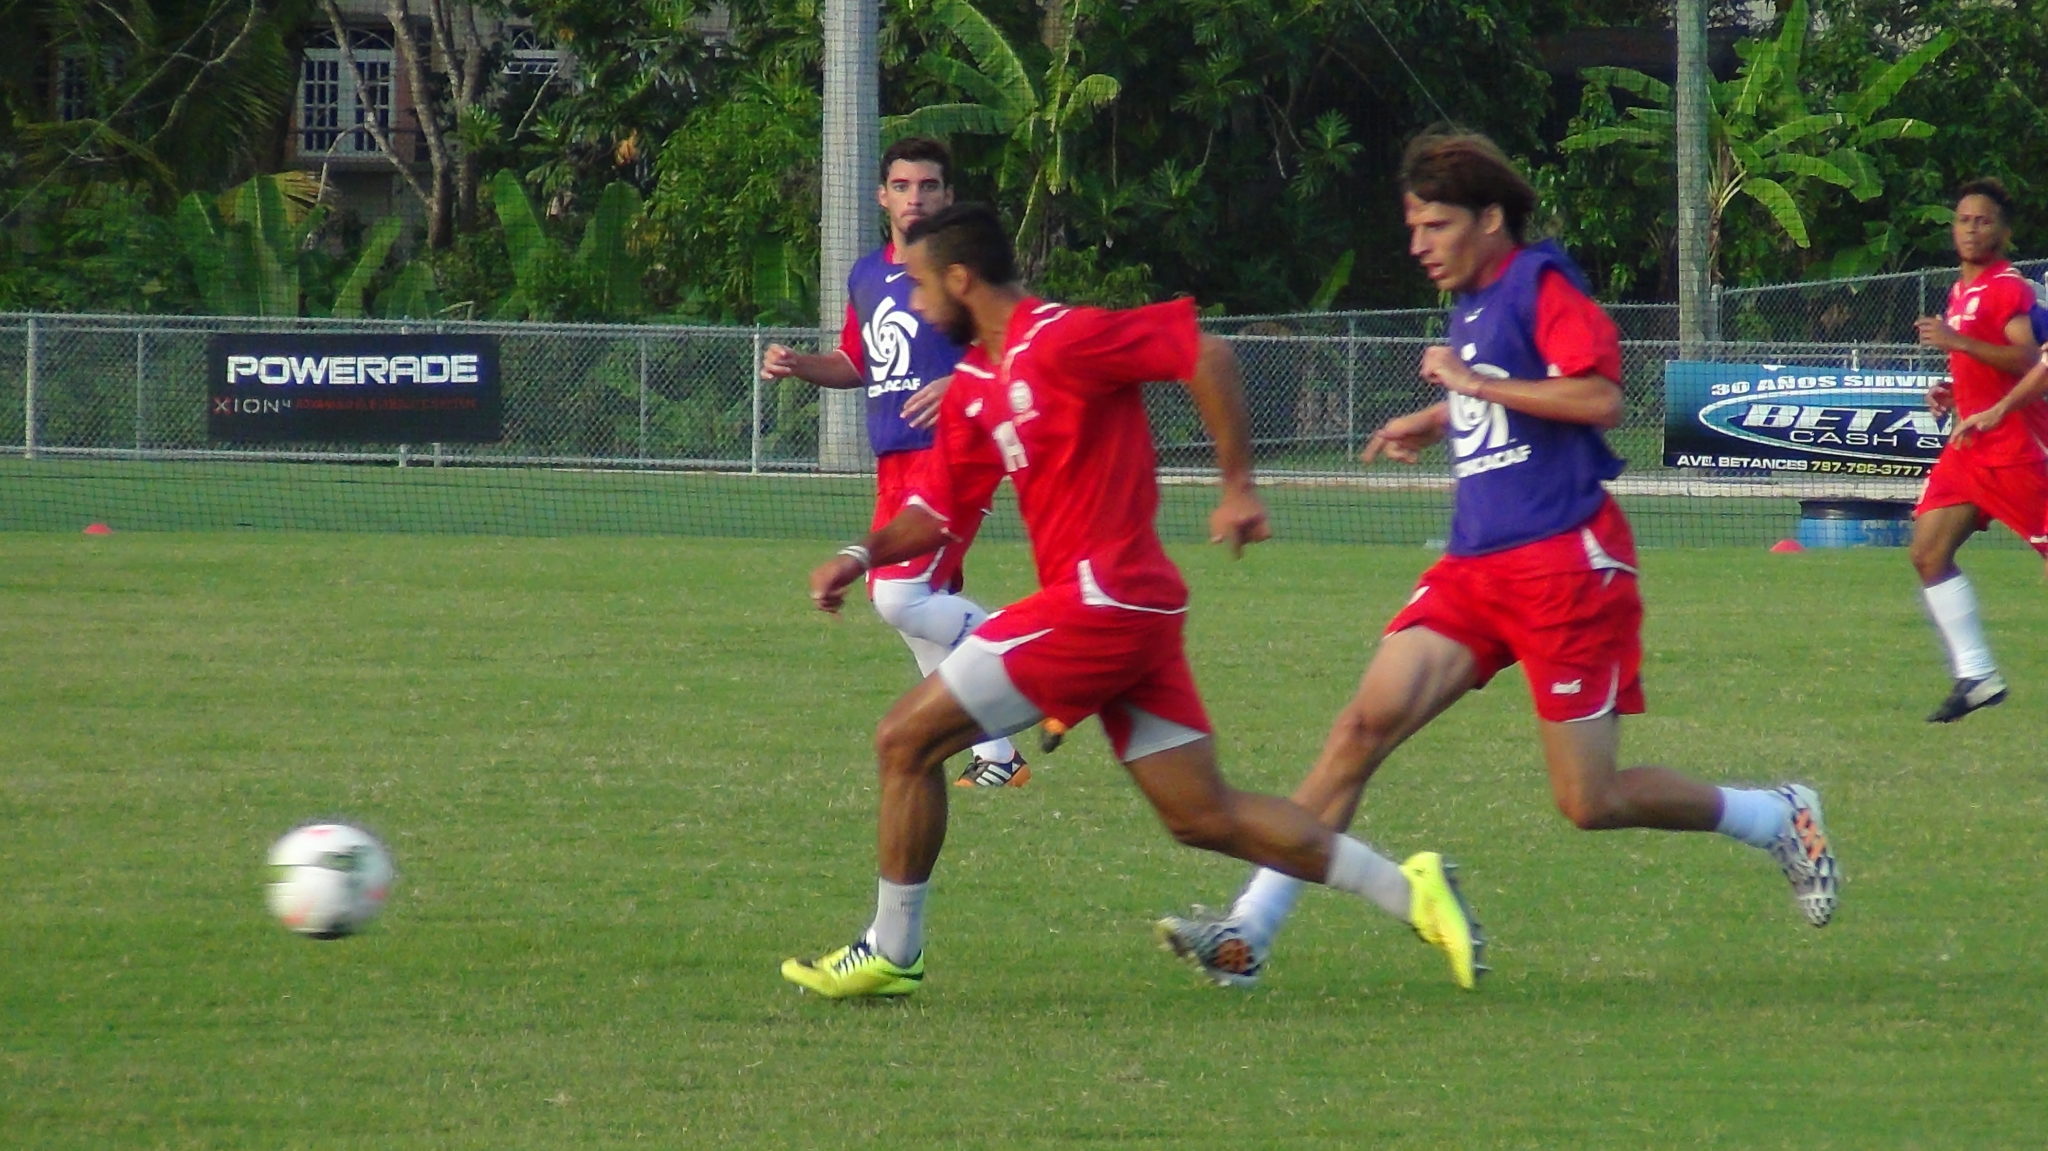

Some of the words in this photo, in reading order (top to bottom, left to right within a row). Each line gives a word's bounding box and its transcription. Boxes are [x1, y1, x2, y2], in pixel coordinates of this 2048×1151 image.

[227, 355, 479, 385] POWERADE
[1711, 381, 1750, 395] 30
[1757, 375, 1837, 391] AÑOS
[1790, 430, 1898, 447] CASH
[1917, 436, 1944, 449] &
[1718, 456, 1808, 471] BETANCES
